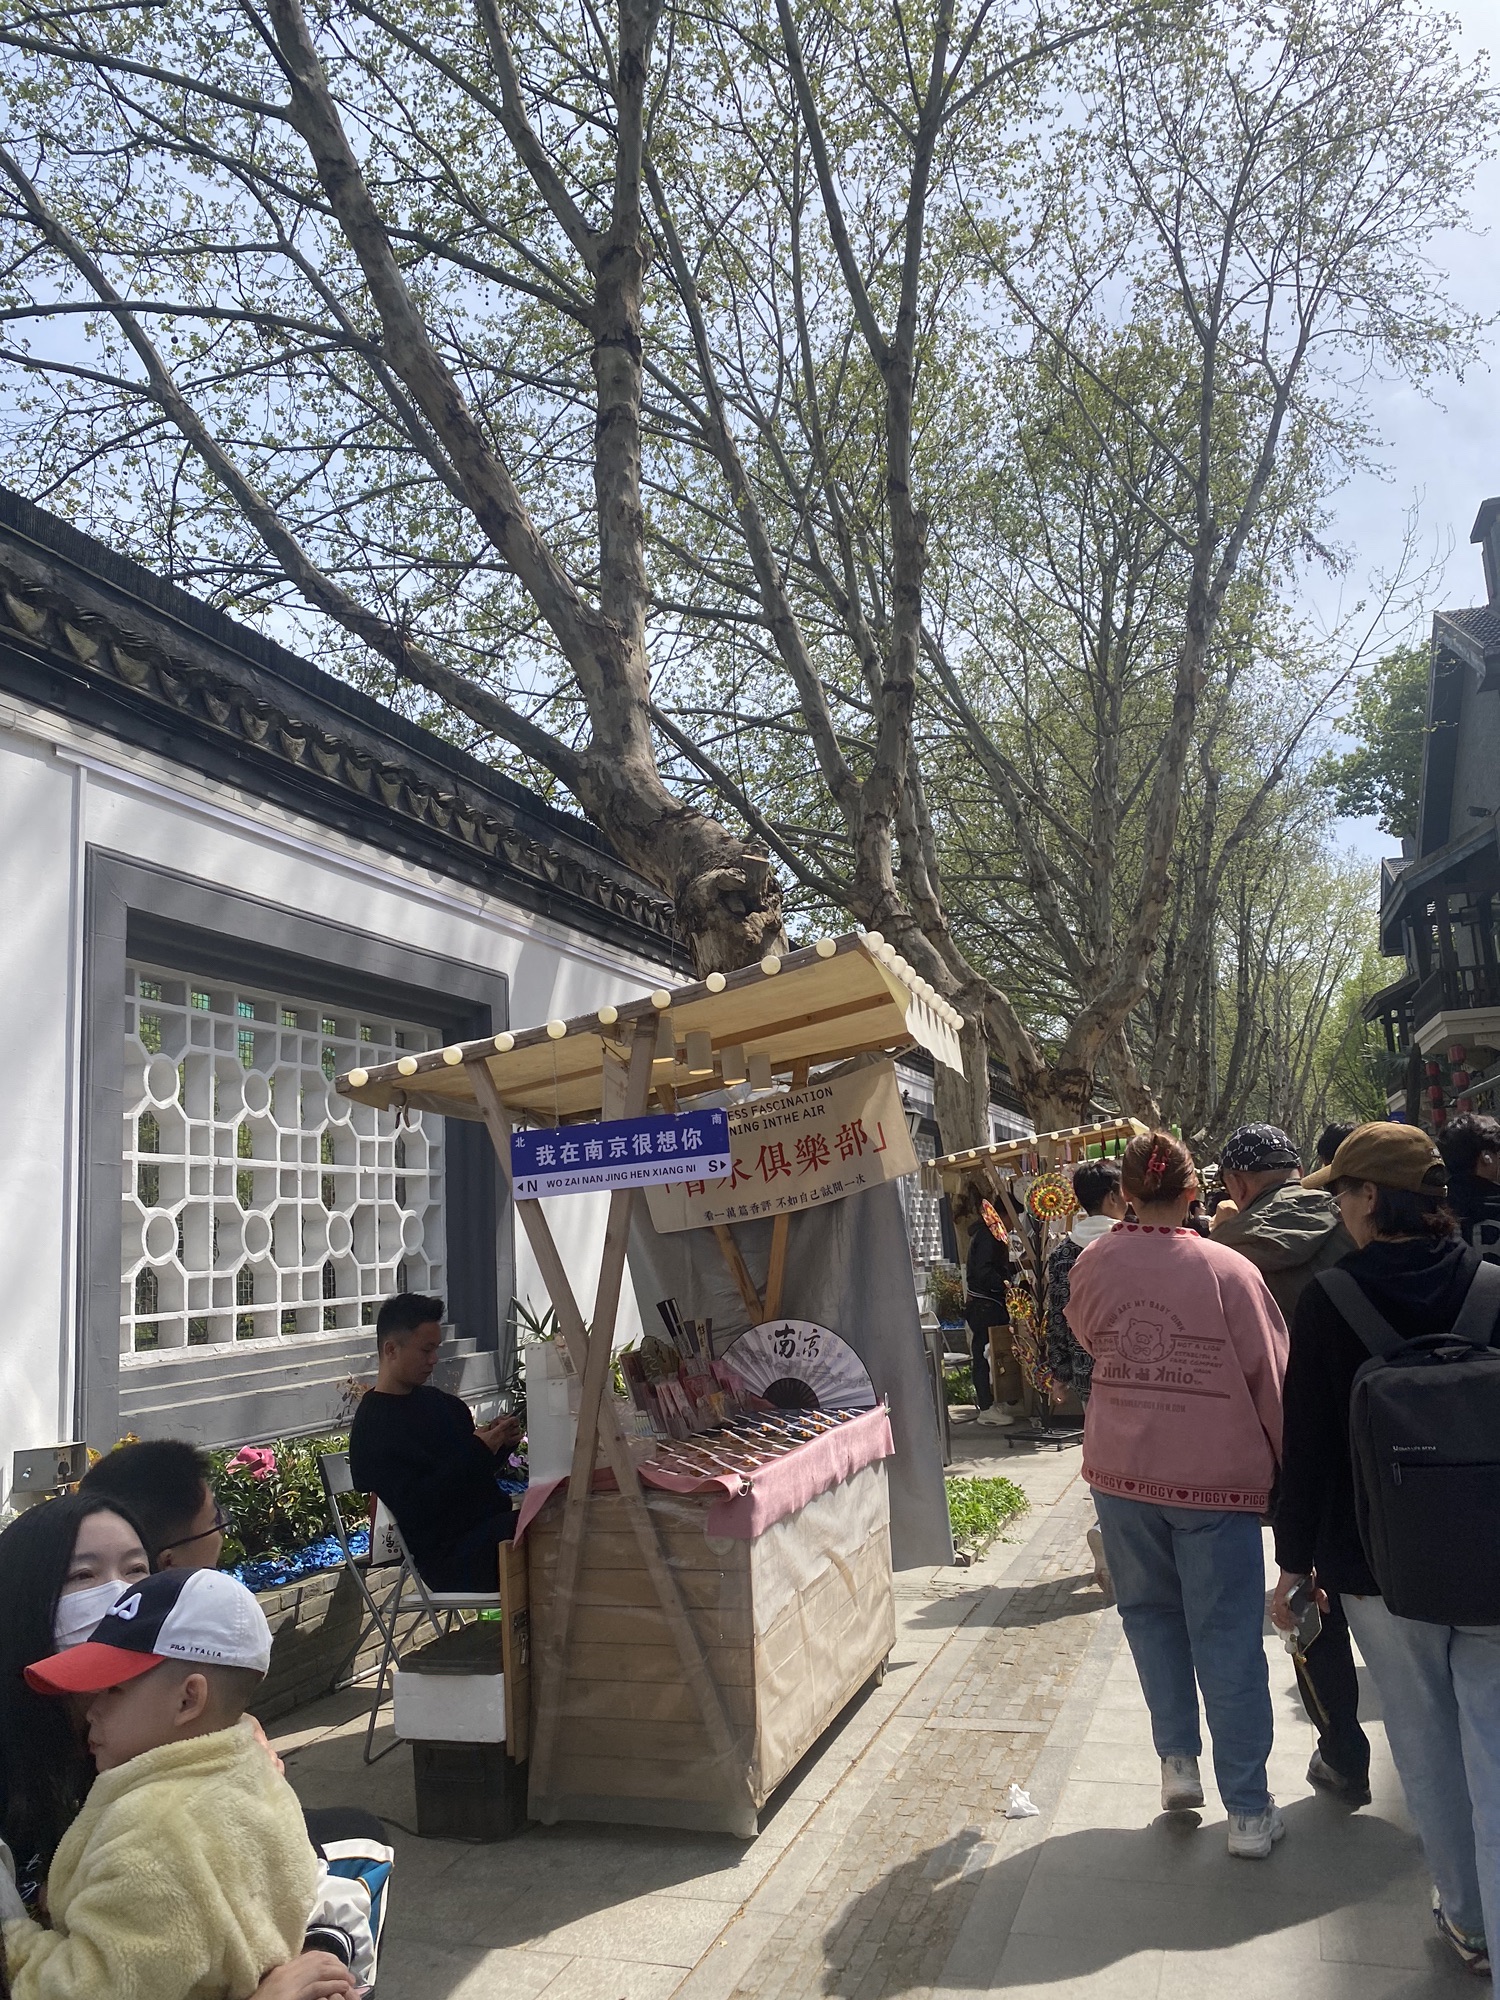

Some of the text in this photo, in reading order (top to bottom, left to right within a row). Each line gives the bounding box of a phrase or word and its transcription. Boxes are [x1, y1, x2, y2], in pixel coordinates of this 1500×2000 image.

[751, 1086, 833, 1117] FASCINATION
[711, 1113, 722, 1126] 南
[803, 1104, 826, 1120] AIR
[515, 1137, 525, 1148] 北
[535, 1127, 704, 1167] 我在南京很想你
[708, 1160, 718, 1173] S
[546, 1179, 562, 1189] WO
[565, 1177, 580, 1187] ZAI
[630, 1168, 650, 1179] HEN
[652, 1165, 684, 1177] XIANG
[685, 1164, 697, 1173] NI
[527, 1180, 538, 1193] N
[1107, 1313, 1118, 1328] YOU
[1118, 1302, 1131, 1314] ARE
[1149, 1301, 1171, 1315] BABY
[773, 1323, 821, 1359] 南京
[1138, 1483, 1174, 1499] PIGGY
[1192, 1491, 1228, 1504] PIGGY
[1243, 1494, 1266, 1506] PIGG
[189, 1646, 222, 1658] ITALIA
